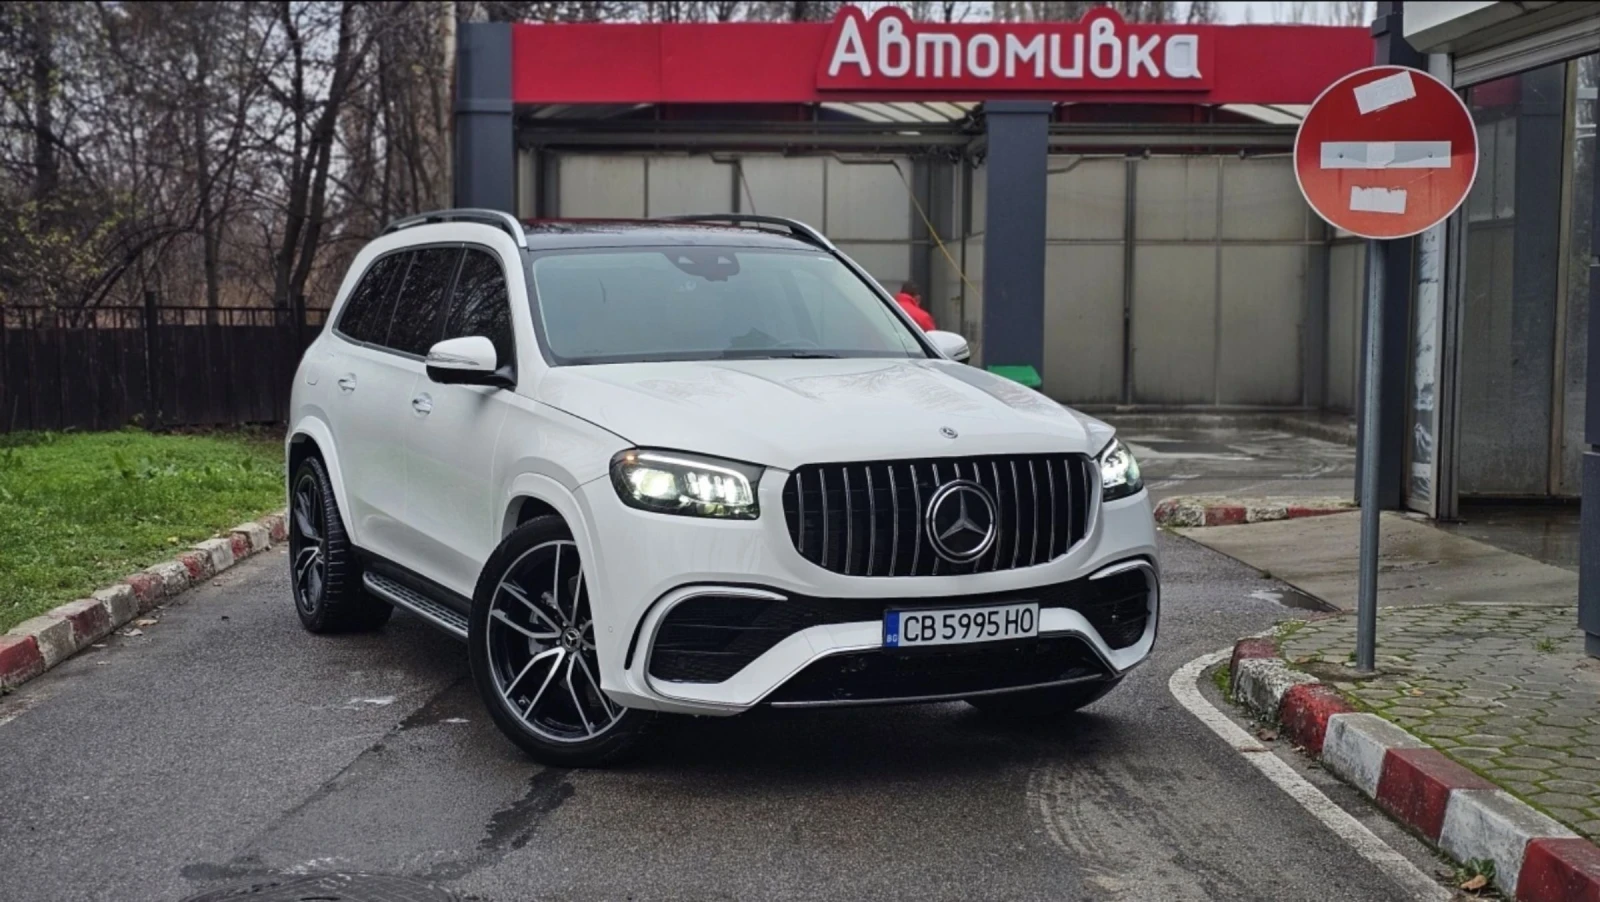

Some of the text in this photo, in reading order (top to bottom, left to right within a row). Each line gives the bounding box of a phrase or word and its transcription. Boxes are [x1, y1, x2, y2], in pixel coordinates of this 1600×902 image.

[828, 15, 1202, 78] Автомивка
[886, 634, 898, 643] BG
[903, 607, 1034, 642] CB 5995 HO
